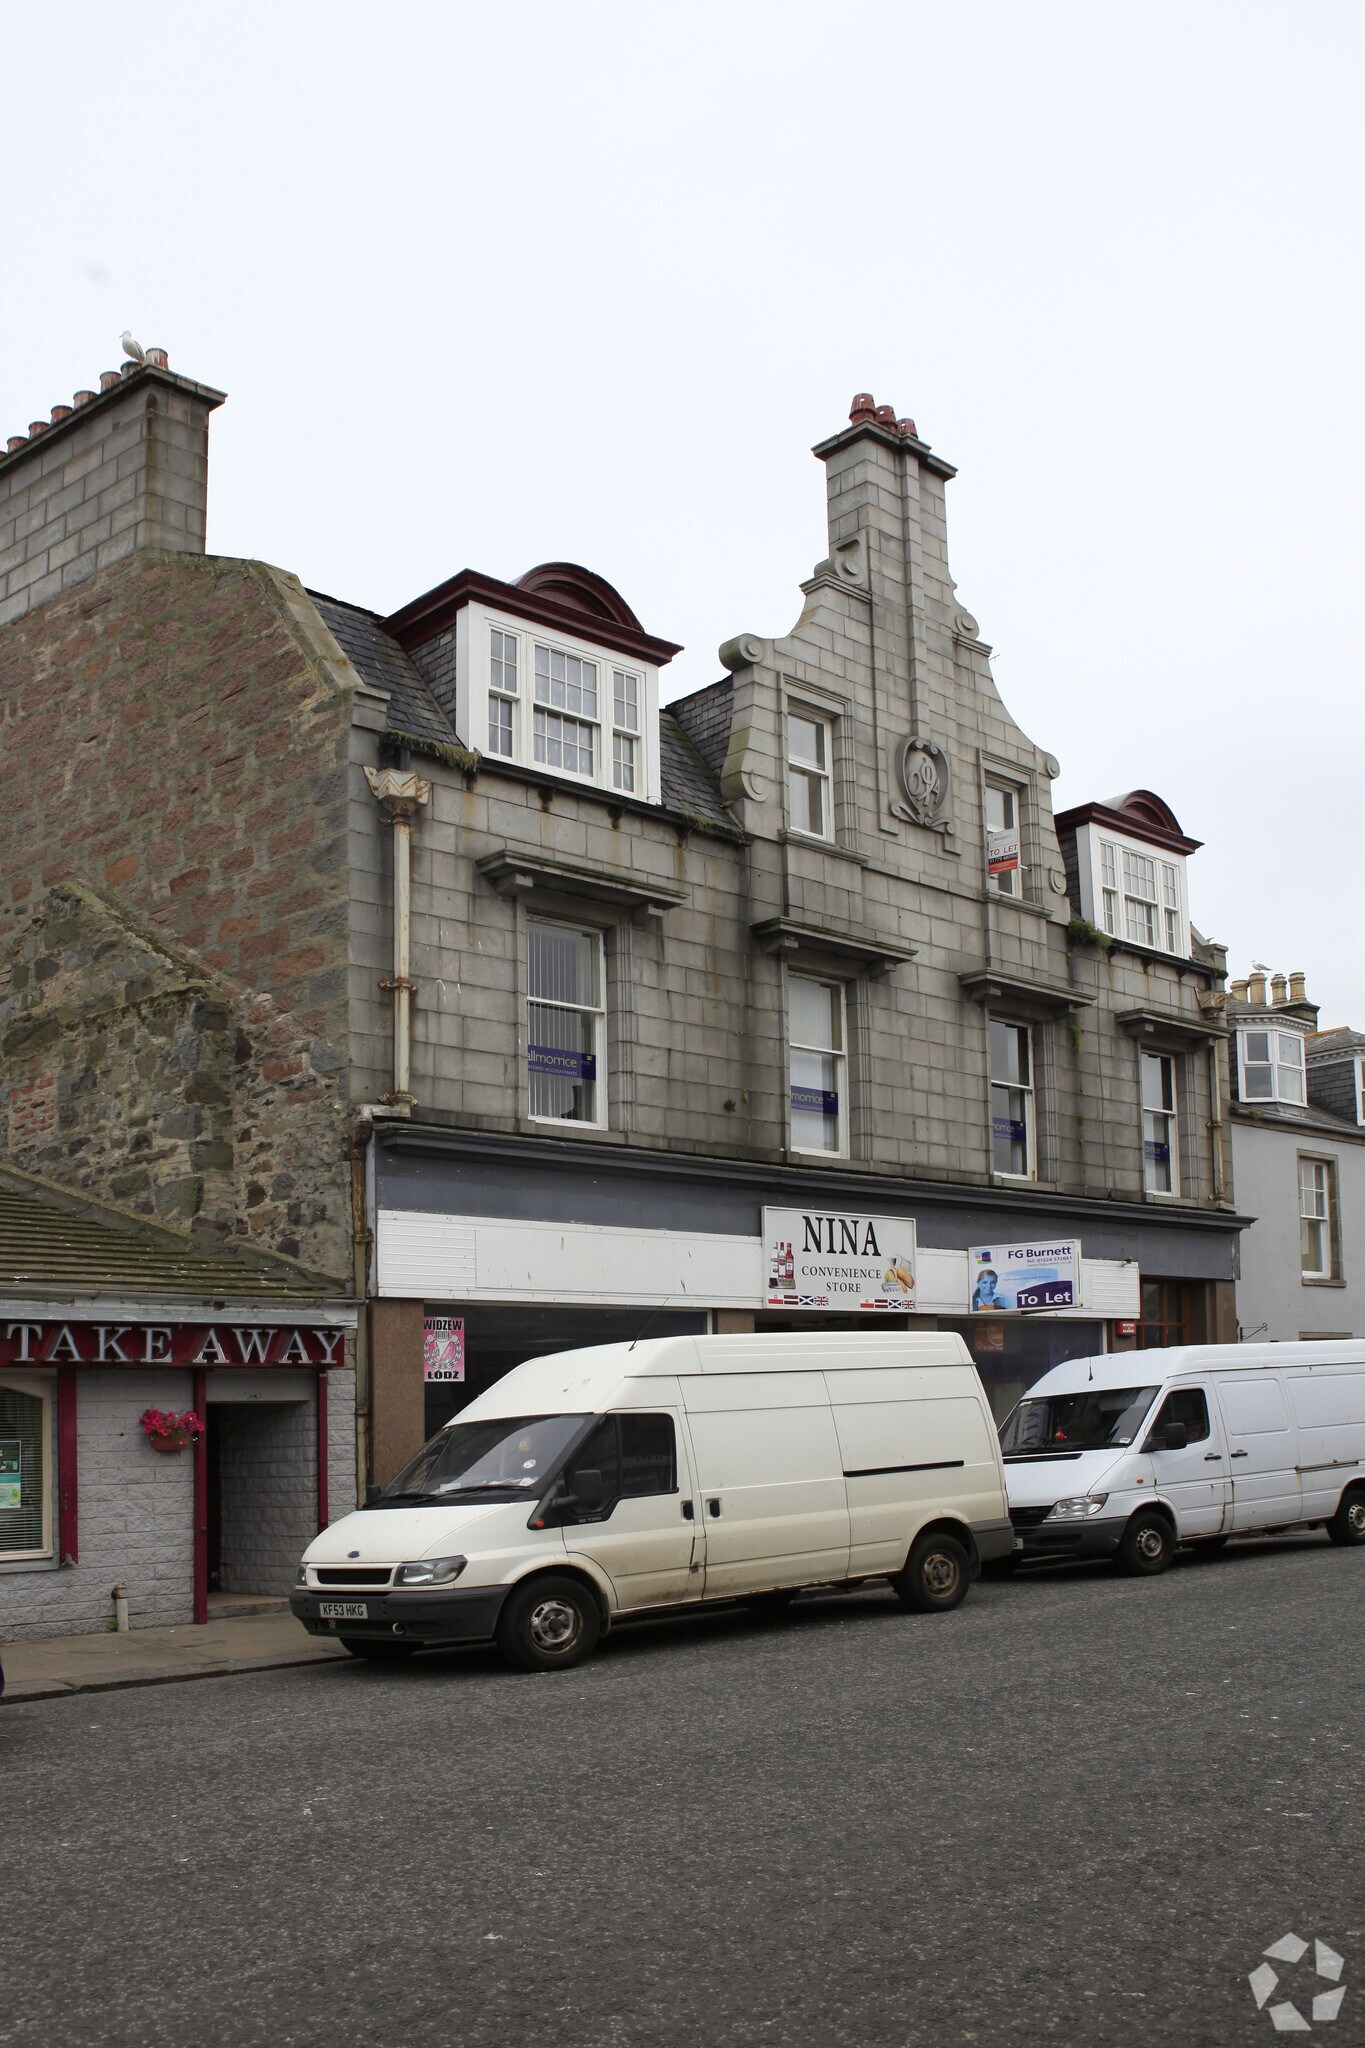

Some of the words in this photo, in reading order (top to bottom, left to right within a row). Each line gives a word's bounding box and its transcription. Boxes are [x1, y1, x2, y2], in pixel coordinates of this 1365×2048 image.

[989, 848, 1000, 856] TO
[1003, 843, 1018, 854] LET
[544, 1067, 578, 1077] ACCOUNTANTS
[802, 1215, 882, 1257] NINA
[1008, 1250, 1024, 1260] FG
[1026, 1246, 1072, 1258] Burnett
[801, 1265, 882, 1279] CONVENIENCE
[826, 1281, 862, 1293] STORE
[1018, 1293, 1039, 1306] To
[1045, 1291, 1072, 1304] Let
[423, 1319, 463, 1331] WIDZEW
[6, 1323, 173, 1363] TAKE
[192, 1327, 345, 1364] AWAY
[427, 1369, 460, 1380] ŁÓDŹ
[322, 1604, 345, 1616] KF53
[346, 1604, 364, 1617] HKG
